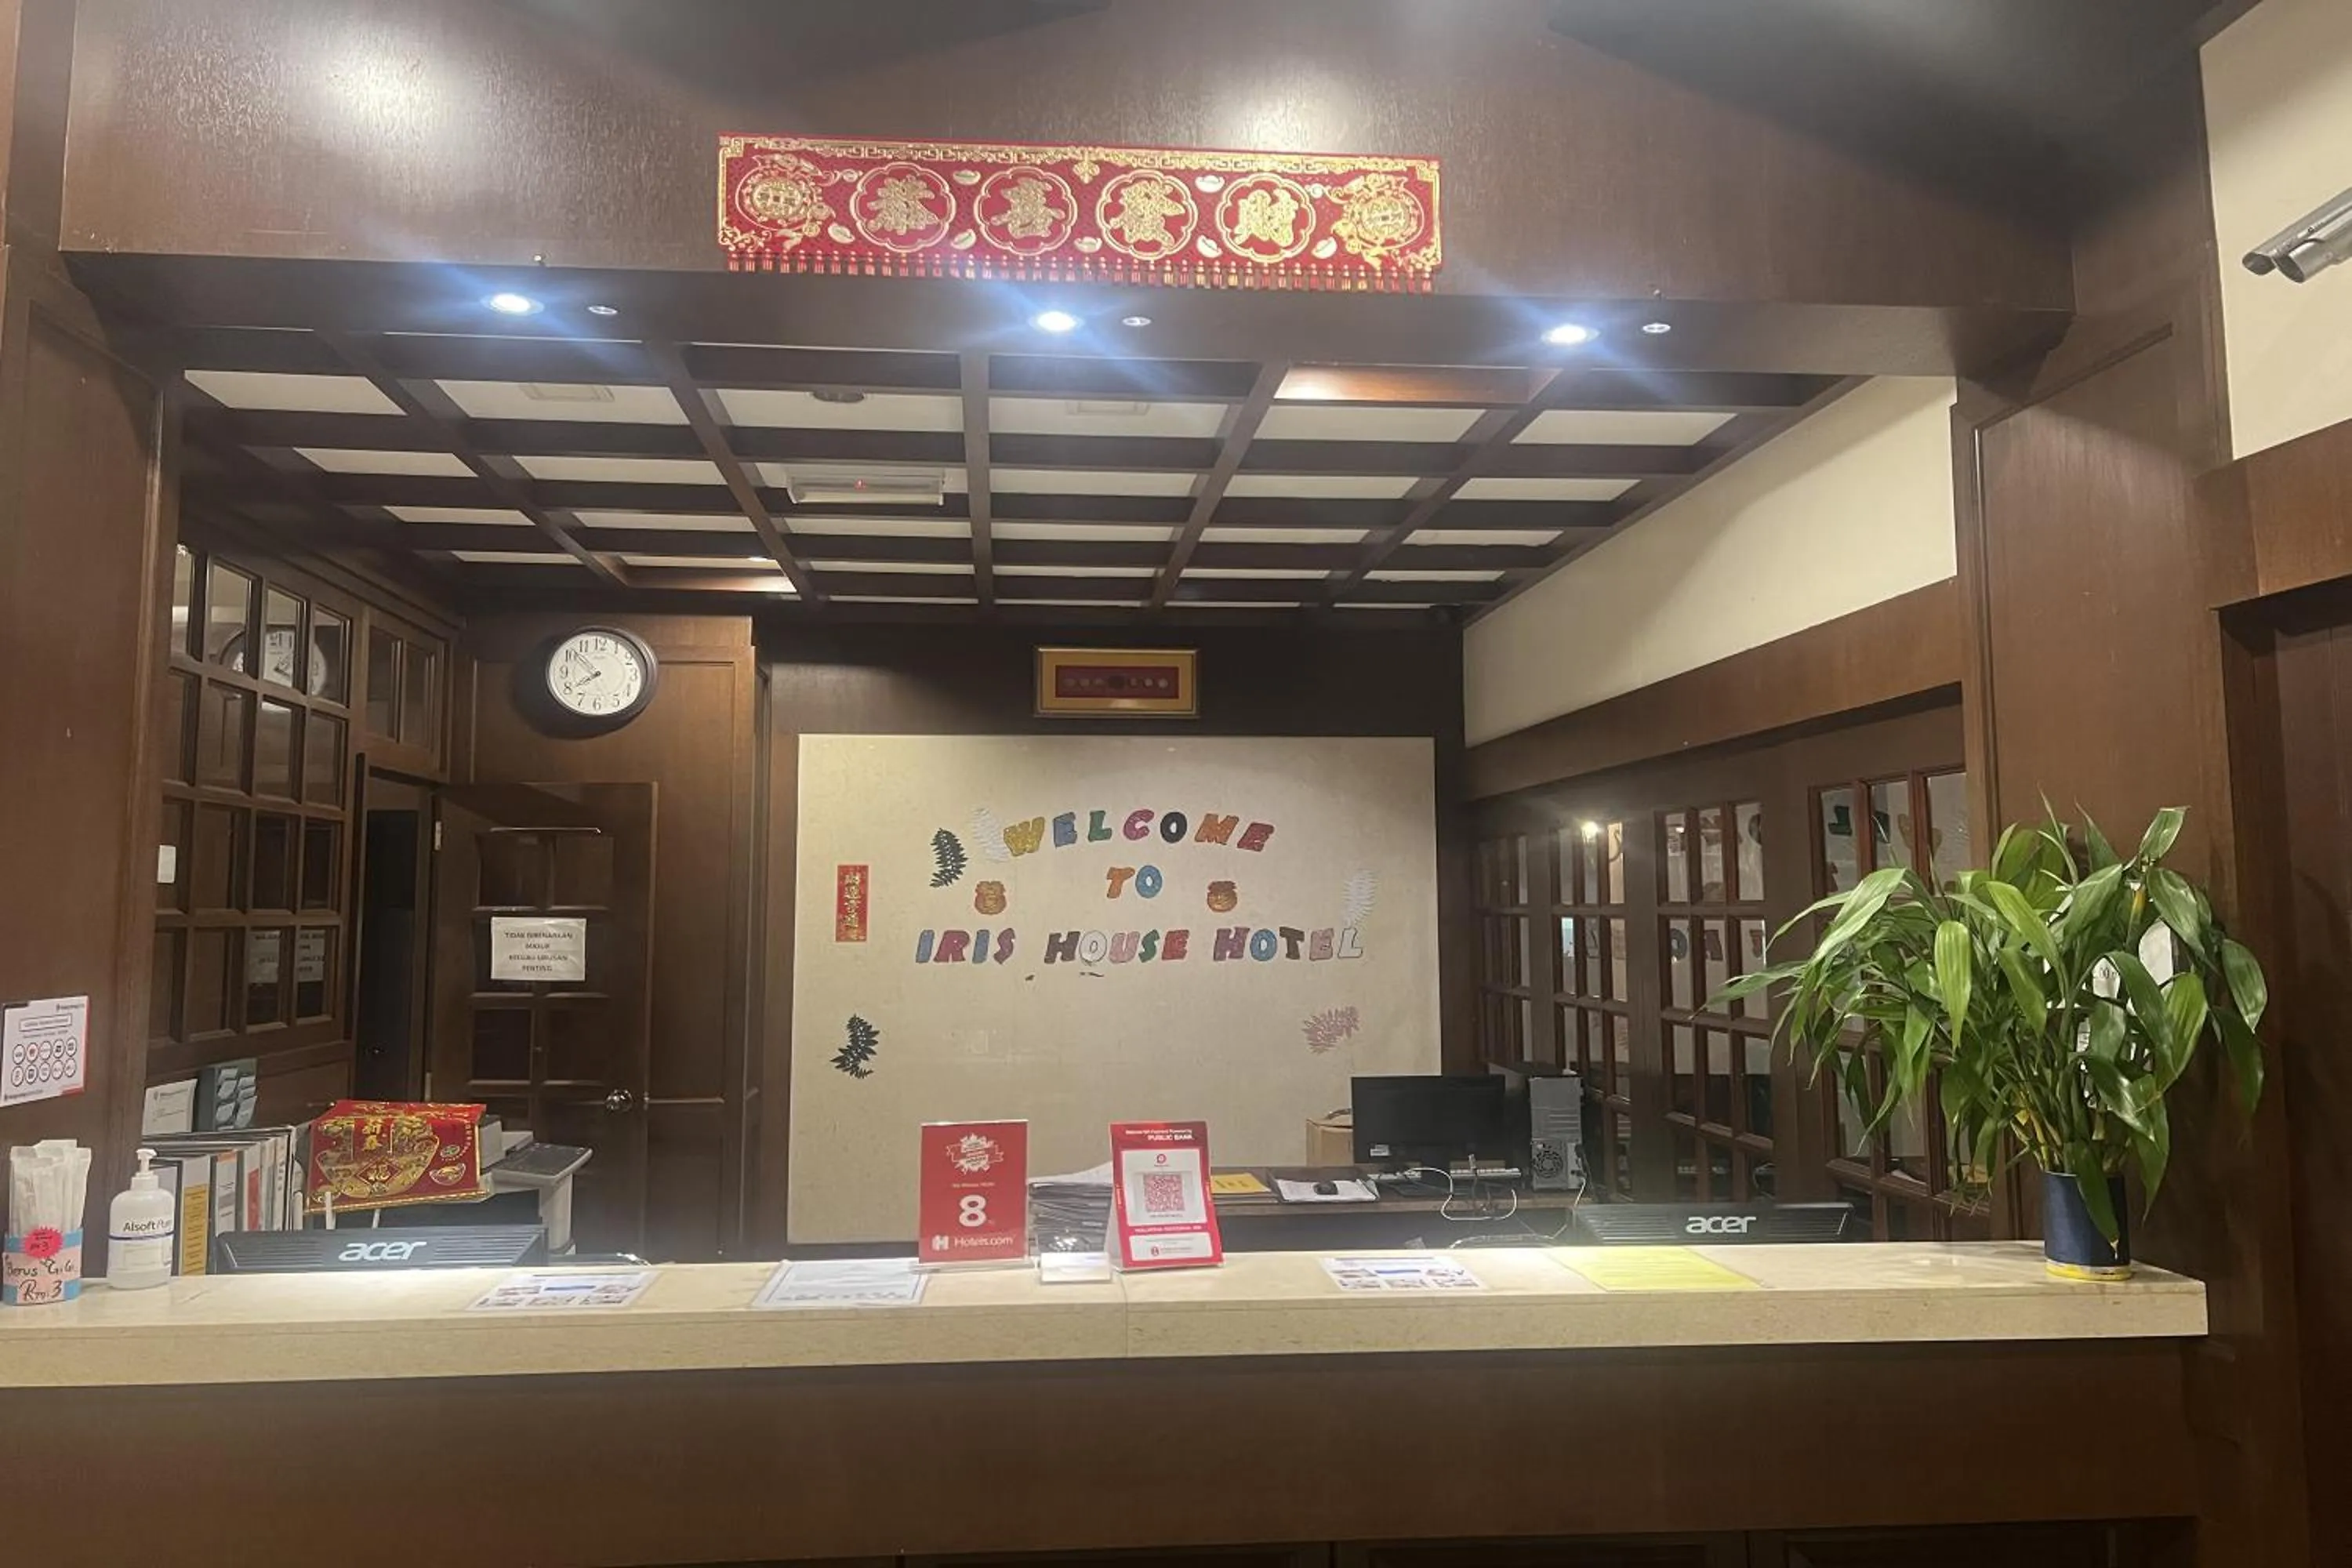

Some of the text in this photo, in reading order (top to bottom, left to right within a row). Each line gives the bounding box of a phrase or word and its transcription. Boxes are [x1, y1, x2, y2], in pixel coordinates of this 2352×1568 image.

[579, 640, 590, 653] 11
[594, 637, 608, 652] 12
[613, 642, 619, 654] 1
[625, 652, 633, 666] 2
[559, 665, 568, 679] 9
[630, 669, 637, 682] 3
[563, 681, 572, 695] 8
[577, 692, 586, 707] 7
[592, 696, 601, 710] 6
[613, 694, 620, 708] 5
[1003, 809, 1274, 856] WELCOME
[1106, 865, 1163, 898] TO
[916, 927, 1364, 965] IRIS HOUSE HOTEL
[959, 1194, 987, 1227] 8
[123, 1221, 155, 1232] Alsoft
[1686, 1216, 1756, 1233] acer
[954, 1236, 1014, 1247] Hotels.com
[338, 1241, 427, 1261] acer
